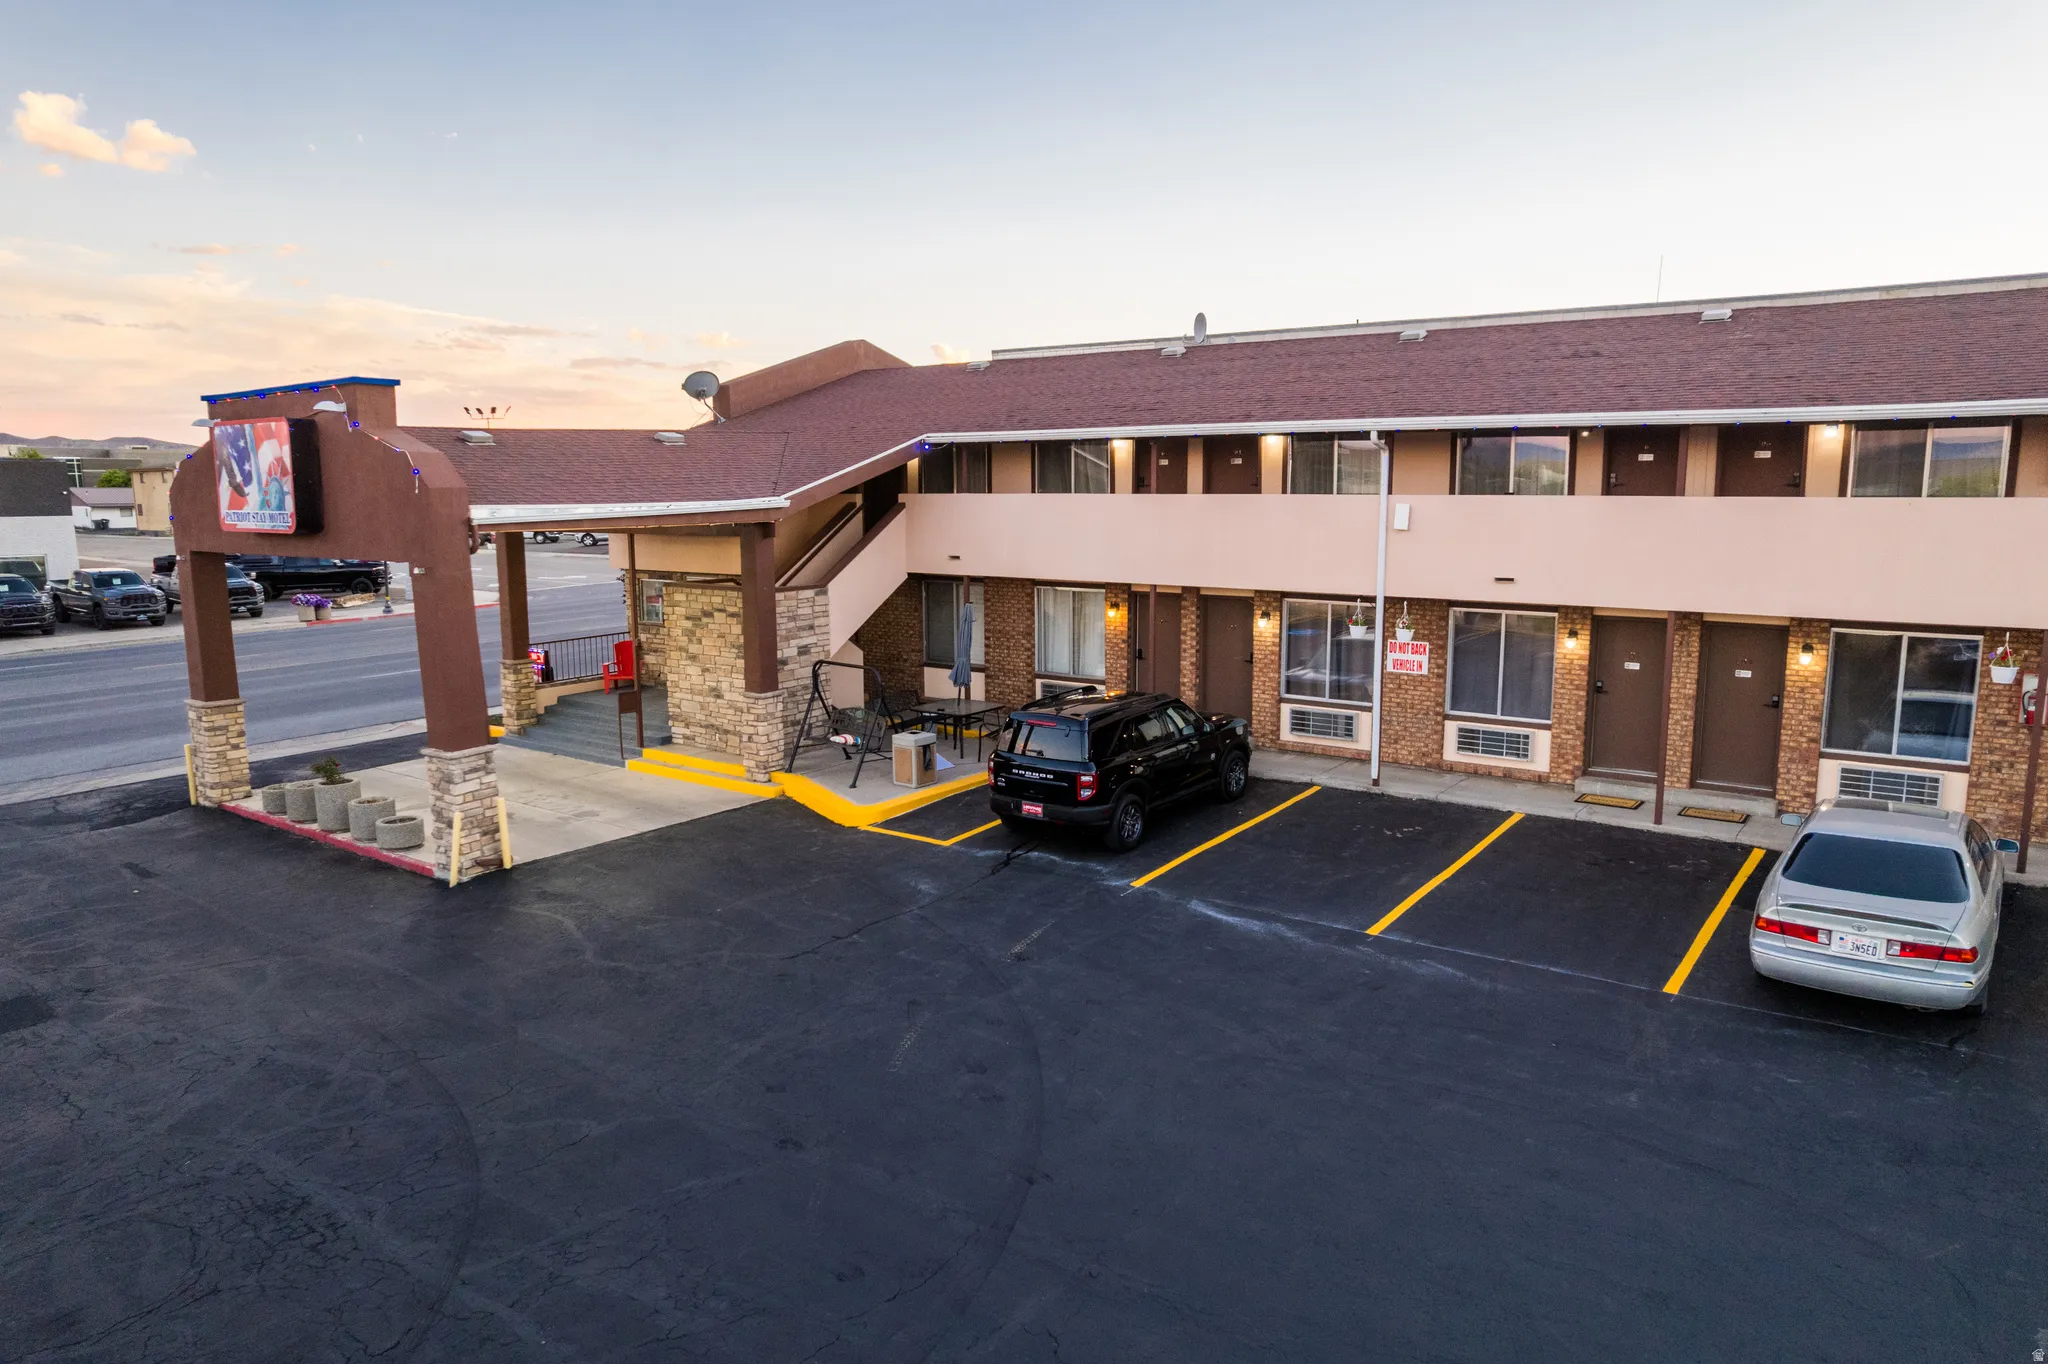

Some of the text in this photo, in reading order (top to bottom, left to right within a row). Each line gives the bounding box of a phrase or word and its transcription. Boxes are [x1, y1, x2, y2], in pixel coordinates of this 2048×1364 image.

[225, 511, 291, 524] PATRIOT STAY MOTEL
[1389, 641, 1427, 656] DO NOT BACK
[1392, 658, 1423, 672] VEHICLE IN
[1012, 768, 1053, 779] BRONCO
